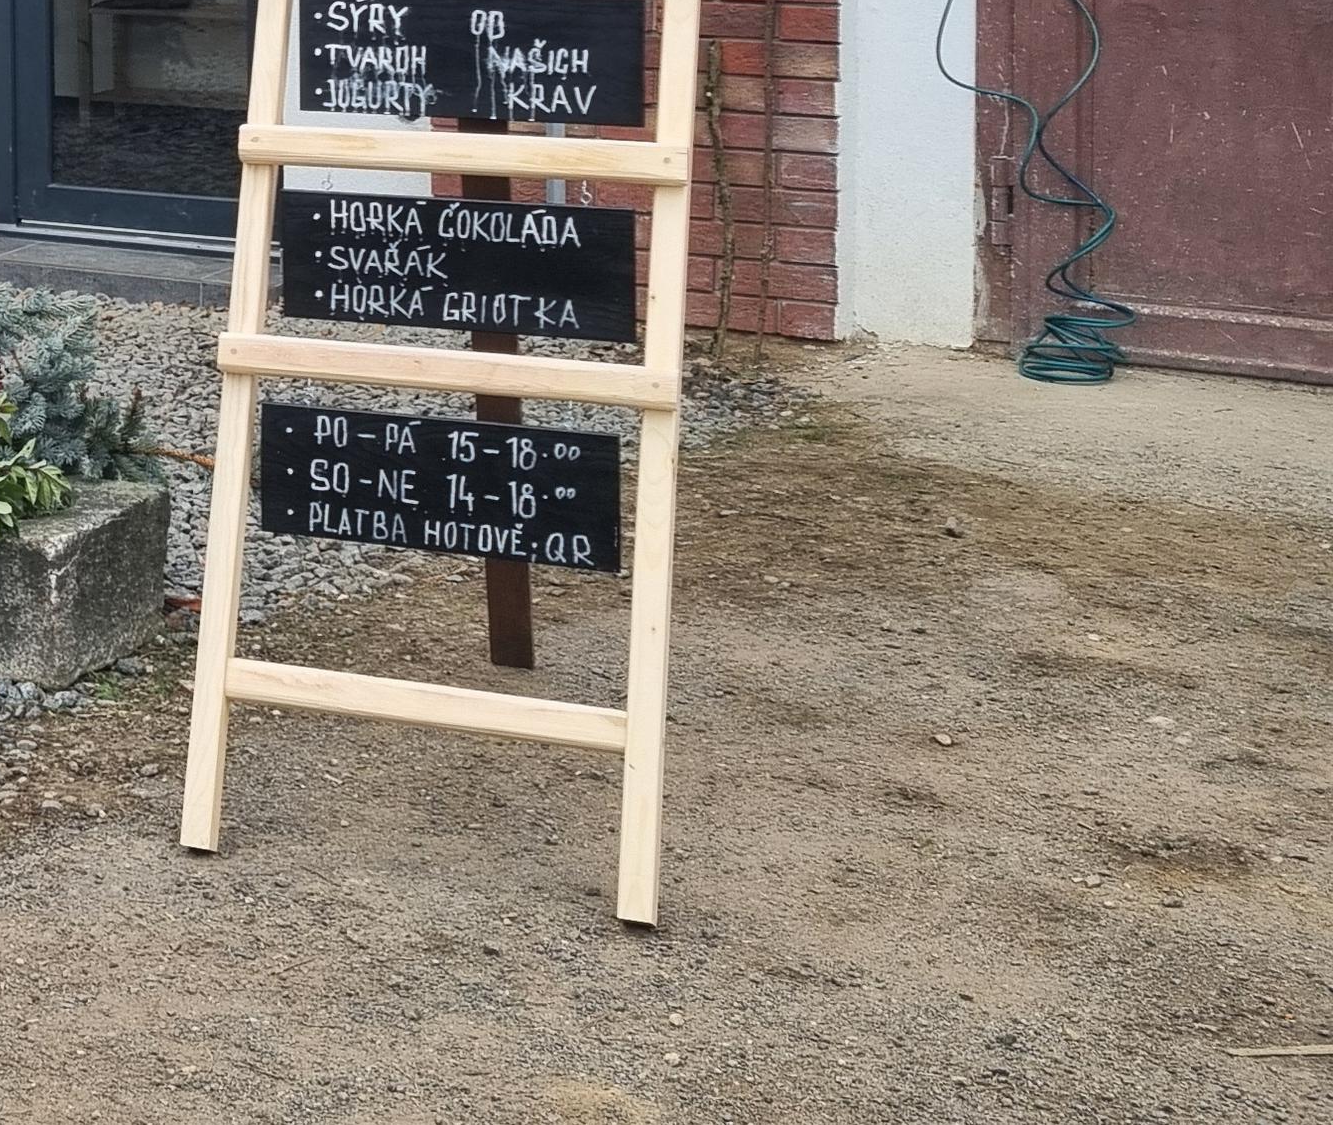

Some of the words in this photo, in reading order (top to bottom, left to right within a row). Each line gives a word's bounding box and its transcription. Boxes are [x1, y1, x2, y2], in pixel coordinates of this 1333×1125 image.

[470, 9, 506, 40] OD
[324, 43, 427, 75] TVAROH
[487, 38, 589, 78] NAŠICH
[507, 82, 597, 115] KRAV
[330, 199, 427, 235] HORKÁ
[438, 202, 582, 248] ČOKOLÁDA
[327, 238, 449, 279] SVAŘÁK
[330, 283, 433, 319] HORKÁ
[442, 292, 580, 329] GRIOTKA
[309, 501, 408, 544] PLATBA
